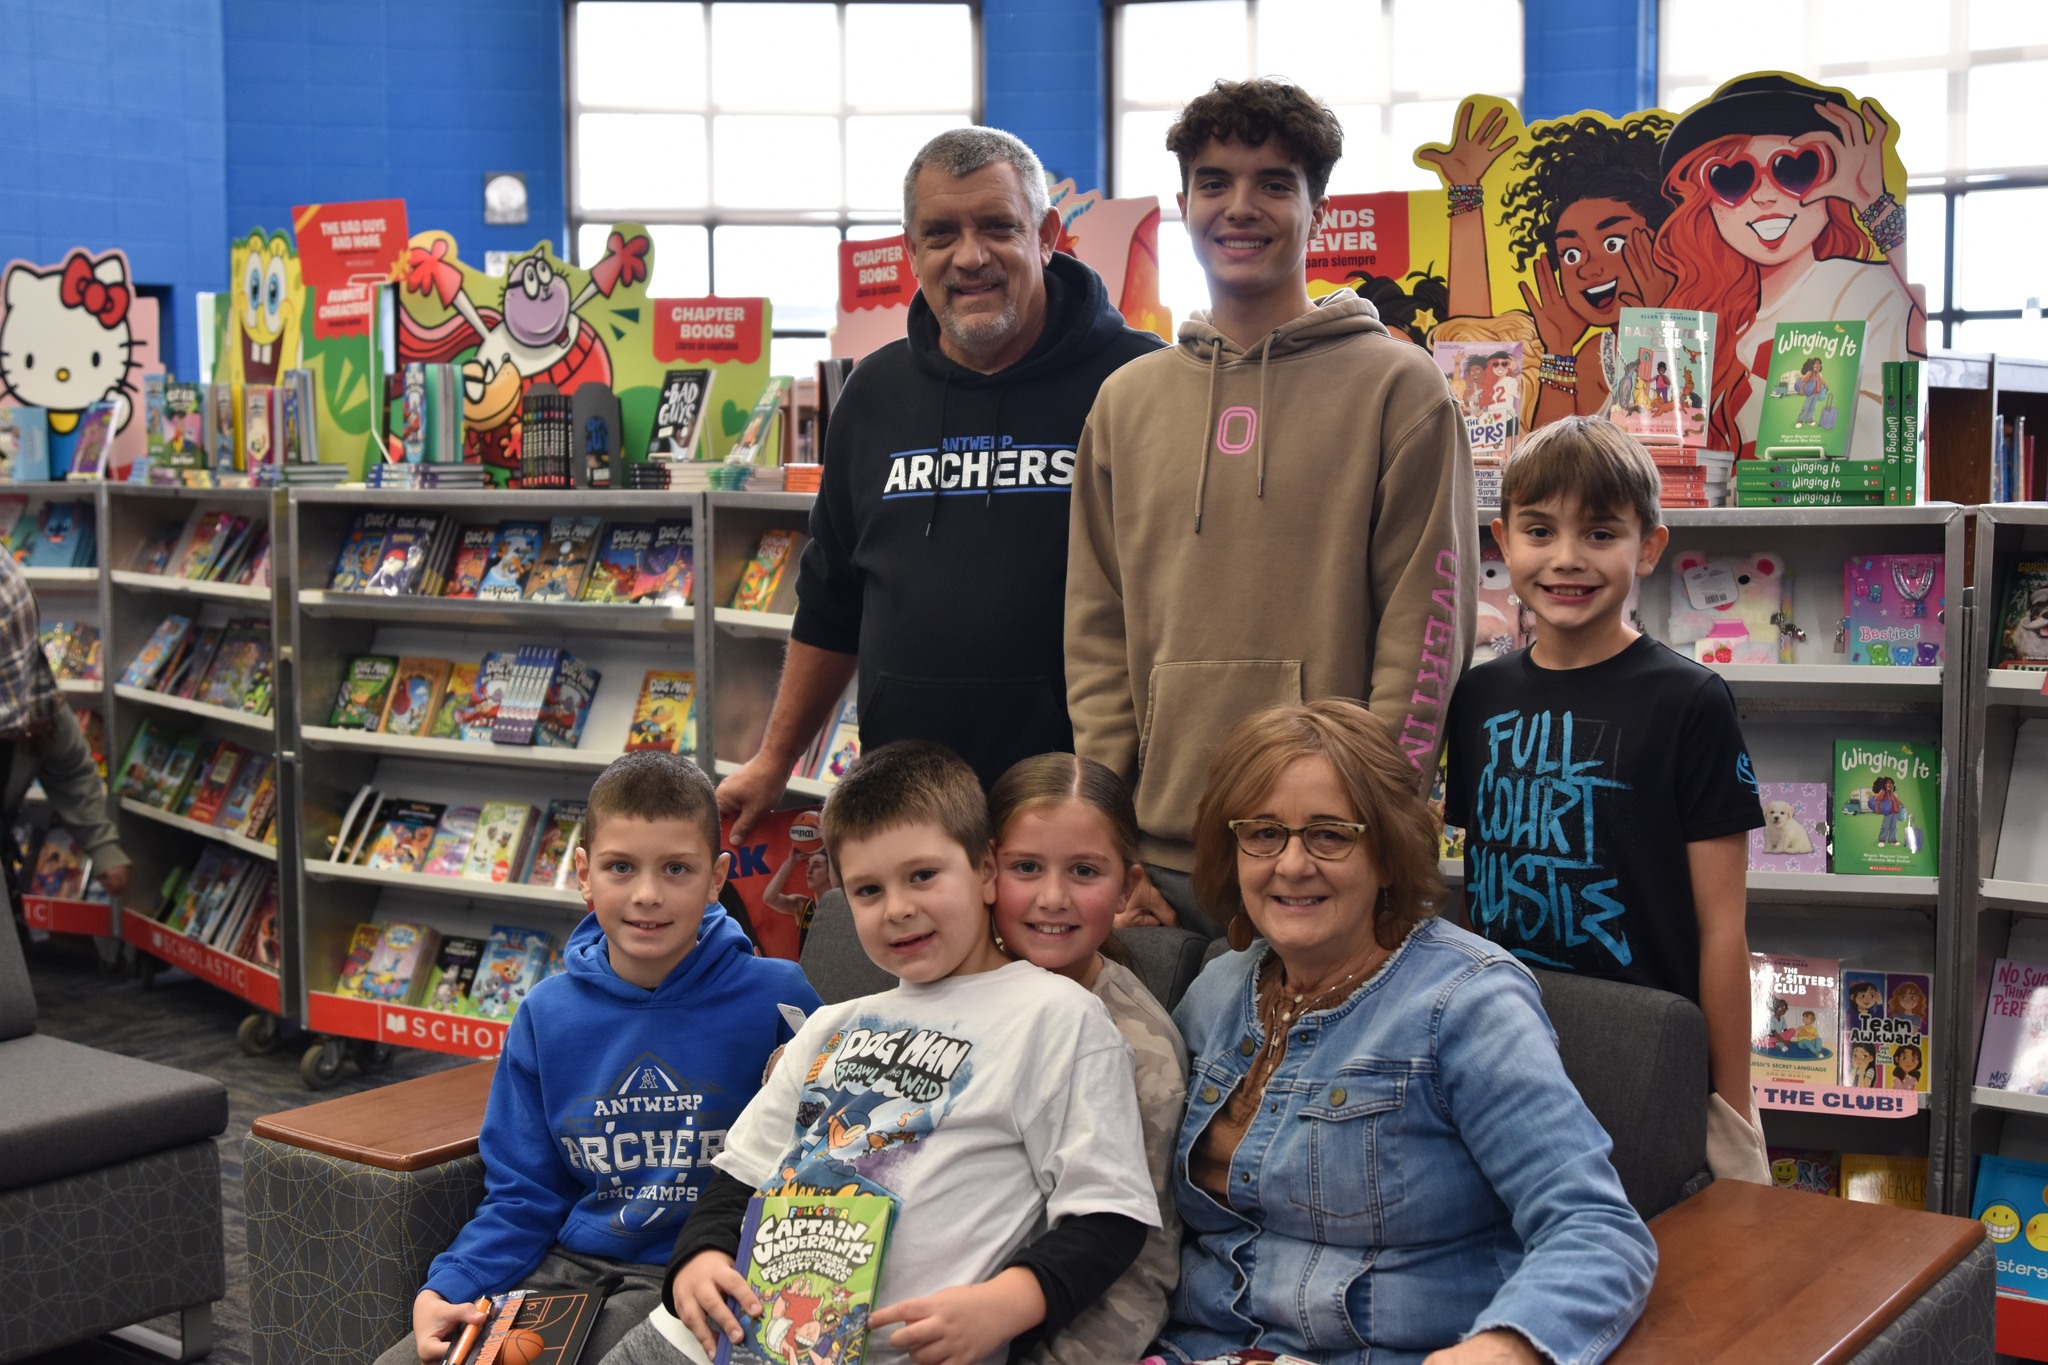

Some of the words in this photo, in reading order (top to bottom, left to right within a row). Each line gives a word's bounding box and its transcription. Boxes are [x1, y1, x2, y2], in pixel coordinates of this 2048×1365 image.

[1322, 208, 1375, 229] NDS
[853, 246, 903, 267] CHAPTER
[1305, 256, 1328, 269] para
[1332, 255, 1376, 268] siempre
[859, 265, 897, 285] BOOKS
[672, 307, 744, 322] CHAPTER
[680, 324, 736, 339] BOOKS
[1625, 326, 1710, 342] BABY-SITTERS
[1651, 338, 1683, 349] CLUB
[1778, 330, 1838, 359] Winging
[1840, 335, 1856, 357] It
[668, 382, 699, 404] BAD
[658, 401, 696, 426] GUYS
[1466, 418, 1480, 427] THE
[1217, 406, 1257, 454] O
[1470, 423, 1504, 444] LORS
[1886, 416, 1899, 453] Winging
[1903, 416, 1916, 453] Winging
[943, 435, 1013, 451] ANTWEP
[1791, 462, 1829, 474] Winging
[1830, 462, 1840, 473] It
[1888, 454, 1899, 465] It
[1904, 454, 1916, 465] It
[883, 450, 1076, 493] ARCHERS
[1792, 477, 1829, 489] Winging
[1830, 477, 1840, 488] It
[1793, 492, 1830, 504] Winging
[1831, 492, 1841, 503] It
[1859, 624, 1921, 642] Besties!
[1399, 549, 1461, 772] OVERTIM
[1483, 709, 1604, 775] FULL
[1841, 748, 1909, 779] Winging
[1912, 757, 1930, 779] It
[1477, 764, 1634, 864] COURT
[1467, 845, 1633, 967] HUSTLE
[163, 932, 247, 989] SCHOLASTIC
[1751, 970, 1835, 988] Y-SITTERS
[1998, 962, 2020, 984] NO
[1773, 983, 1807, 995] CLUB
[1992, 994, 2032, 1018] PERF
[1860, 1014, 1912, 1034] Team
[1850, 1029, 1922, 1046] Awkward
[838, 1029, 900, 1064] DOG
[897, 1029, 973, 1080] MAN
[1793, 1065, 1827, 1073] LANGUAGE
[836, 1061, 880, 1084] BRAWL
[900, 1069, 943, 1101] WILD
[594, 1095, 703, 1116] ANTWERP
[1764, 1088, 1815, 1106] THE
[1822, 1092, 1904, 1112] CLUB!
[560, 1129, 728, 1174] ARCHER
[635, 1185, 699, 1201] CHAMPS
[789, 1206, 814, 1218] FULL
[815, 1204, 849, 1219] COLOR
[755, 1216, 868, 1244] CAPTAIN
[752, 1234, 875, 1264] UNDERPANTS
[1997, 1258, 2048, 1279] sters
